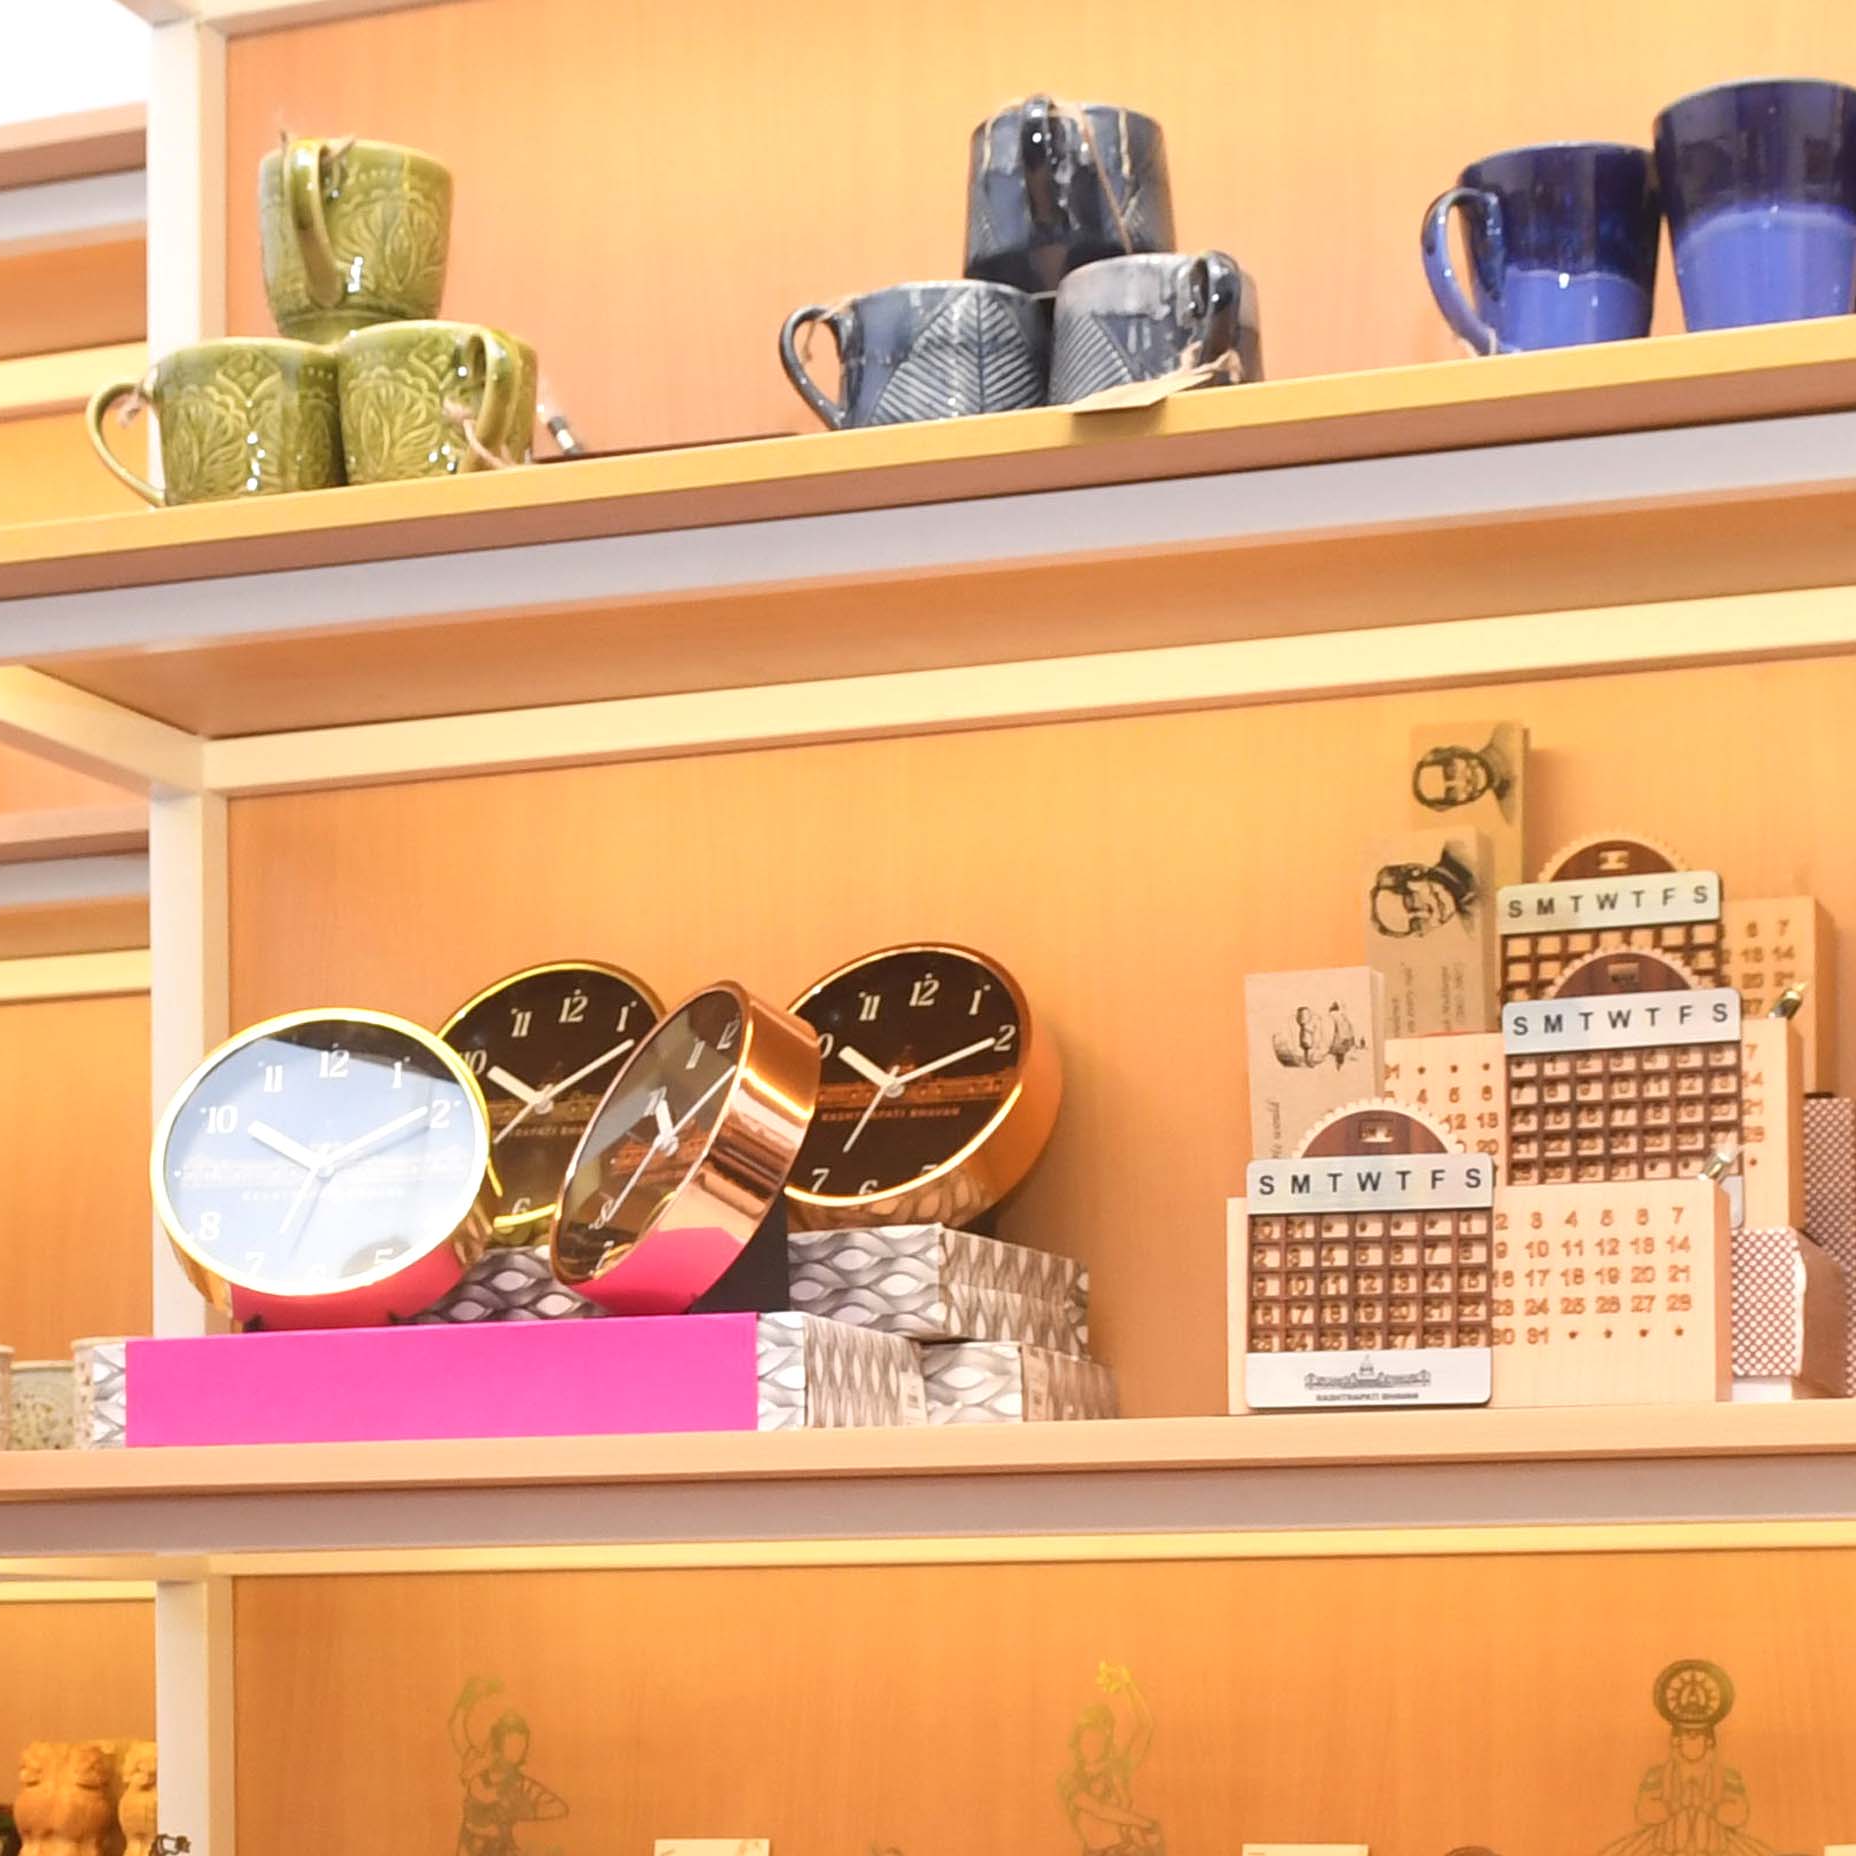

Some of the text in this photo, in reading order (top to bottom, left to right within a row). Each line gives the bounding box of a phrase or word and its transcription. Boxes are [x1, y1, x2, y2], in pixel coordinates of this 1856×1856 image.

[1507, 886, 1708, 918] S M T W T F S
[859, 980, 982, 1021] 11 12 1
[511, 996, 630, 1038] 11 12 1
[1514, 1004, 1728, 1036] S M T W T F S
[685, 1019, 741, 1070] 11 12
[994, 1024, 1016, 1051] 2
[264, 1050, 403, 1093] 11 12 1
[205, 1100, 450, 1134] 10 2
[811, 1168, 830, 1193] 7
[1259, 1168, 1482, 1196] S M T W T F S
[198, 1211, 222, 1240] 8
[1496, 1213, 1509, 1230] 2
[1564, 1210, 1578, 1228] 4
[1672, 1206, 1684, 1224] 7
[1496, 1241, 1508, 1259] 9
[1525, 1240, 1550, 1258] 10
[1562, 1239, 1584, 1257] 11
[1596, 1238, 1620, 1256] 12
[1666, 1235, 1691, 1254] 14
[1525, 1268, 1550, 1287] 17
[1560, 1268, 1585, 1286] 18
[1596, 1266, 1621, 1284] 19
[1631, 1266, 1656, 1284] 20
[1668, 1264, 1691, 1282] 21
[1524, 1298, 1550, 1316] 24
[1631, 1295, 1656, 1313] 27
